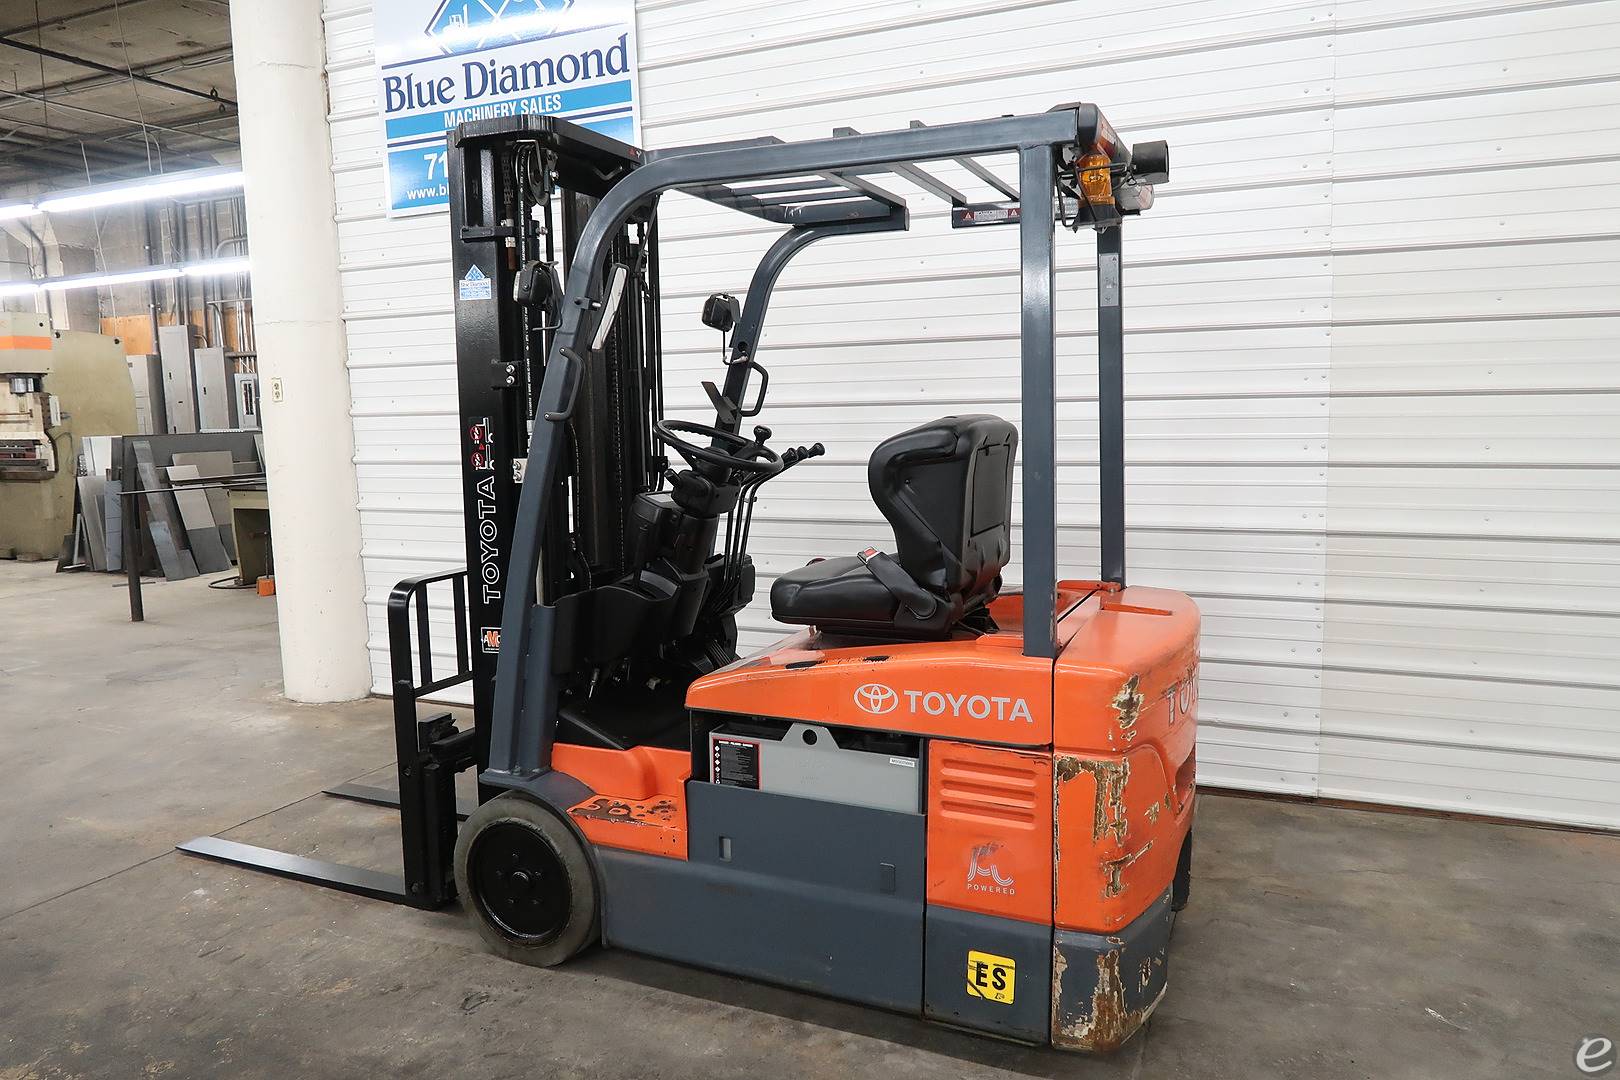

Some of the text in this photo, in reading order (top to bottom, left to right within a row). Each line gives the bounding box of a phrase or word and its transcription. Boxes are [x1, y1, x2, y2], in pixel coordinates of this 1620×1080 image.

[382, 32, 630, 113] Blue Diamond
[520, 94, 562, 116] SALES
[477, 475, 501, 604] TOYOTA
[903, 689, 1033, 723] TOYOTA
[967, 883, 1015, 895] POWERED
[975, 960, 1007, 991] ES
